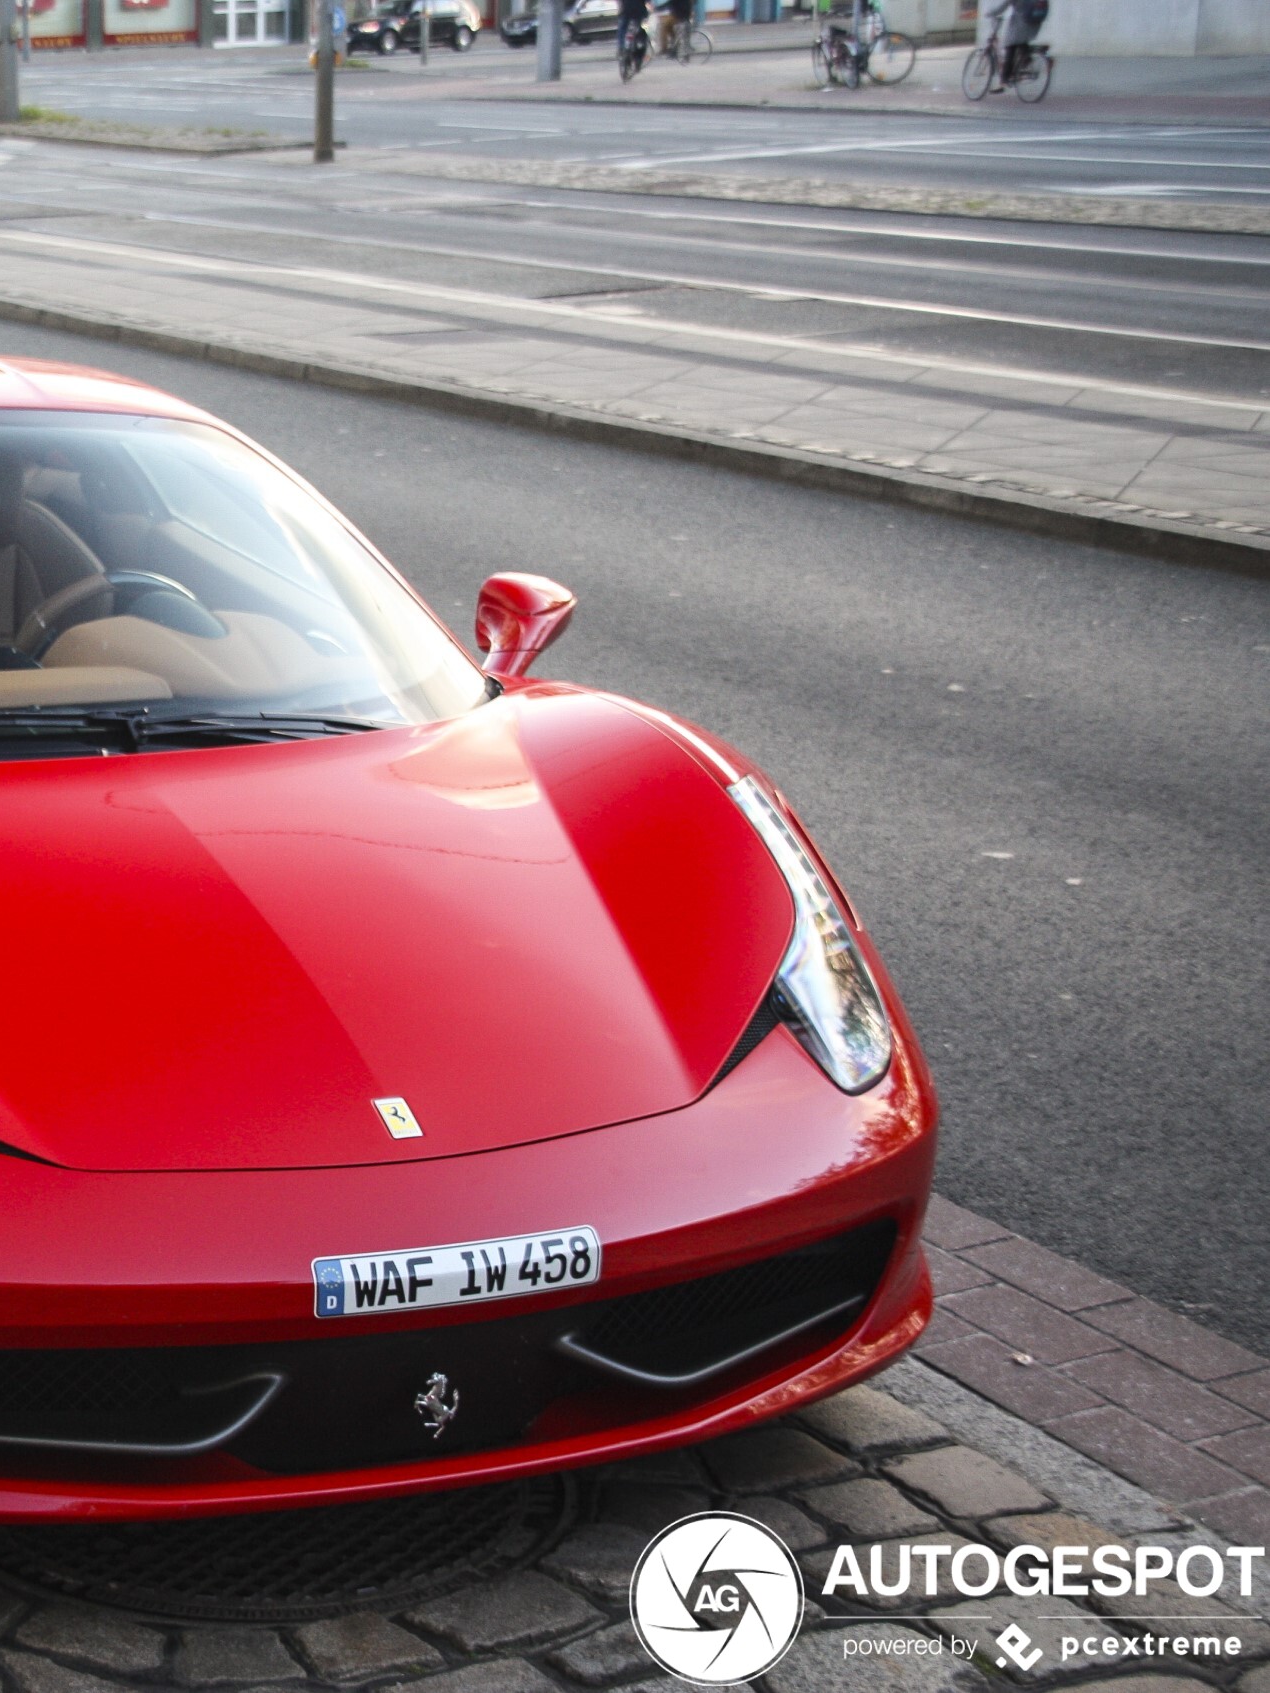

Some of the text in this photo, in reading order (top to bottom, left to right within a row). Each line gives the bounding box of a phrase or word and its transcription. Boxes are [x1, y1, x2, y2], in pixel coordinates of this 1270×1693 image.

[350, 1236, 591, 1308] WAF IW 458
[326, 1296, 338, 1309] D
